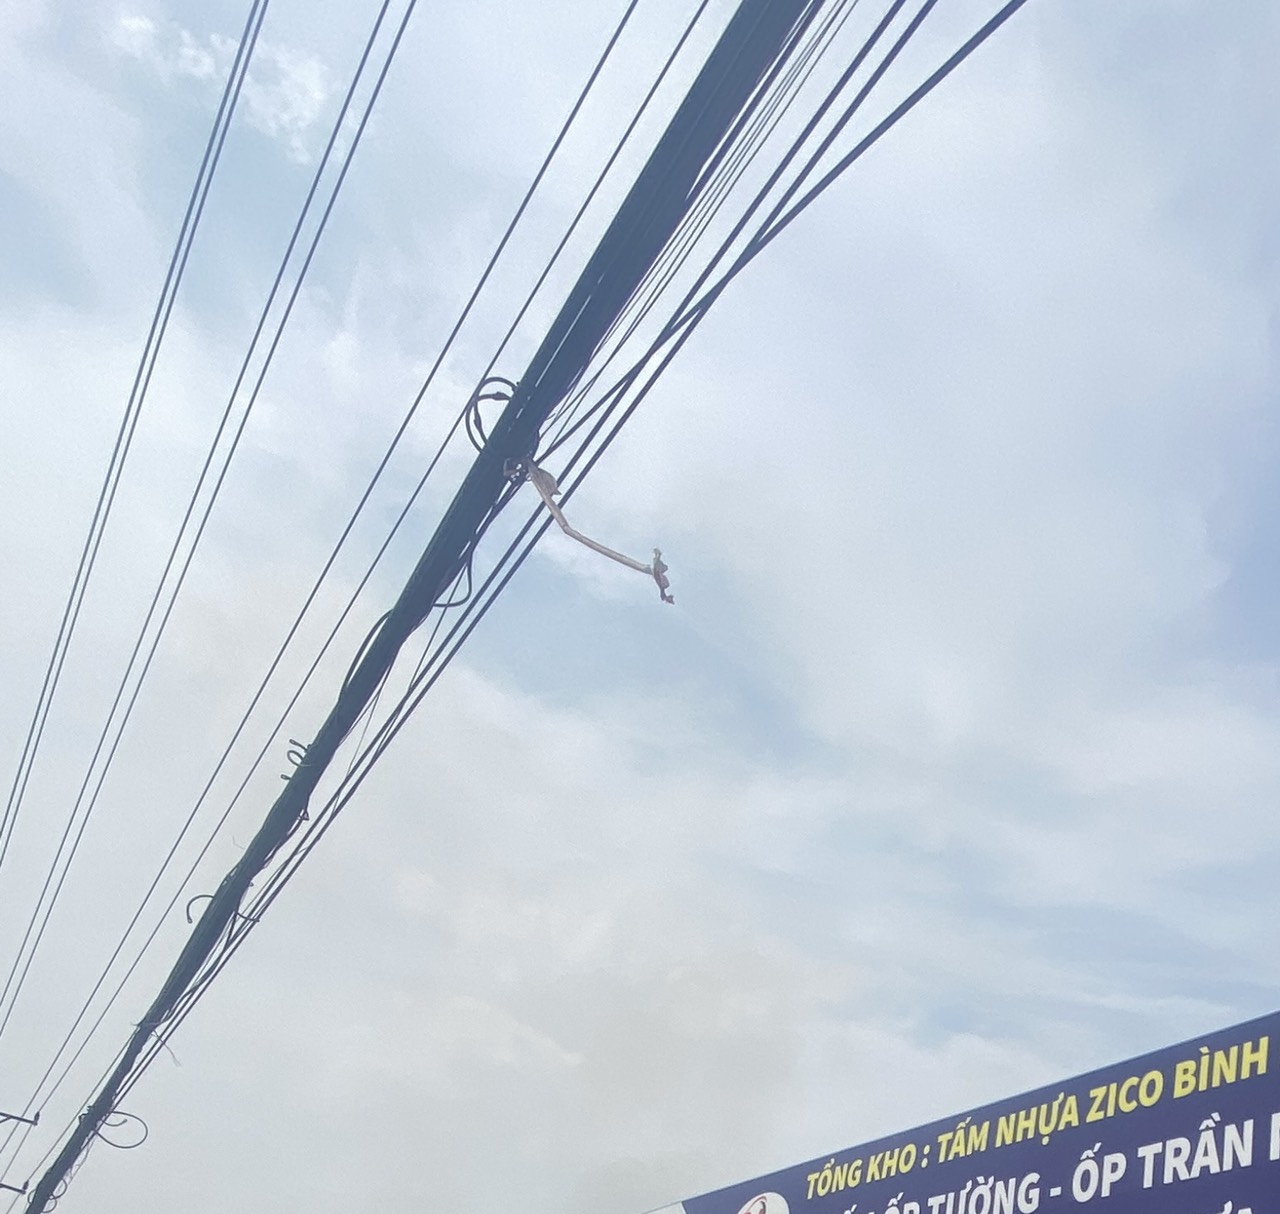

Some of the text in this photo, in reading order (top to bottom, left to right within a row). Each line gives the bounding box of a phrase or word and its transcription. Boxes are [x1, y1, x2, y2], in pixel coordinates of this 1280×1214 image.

[807, 1158, 863, 1200] TỔNG
[866, 1143, 916, 1182] KHO
[937, 1117, 990, 1164] TẤM
[995, 1092, 1079, 1145] NHỰA
[1086, 1069, 1164, 1123] ZICO
[1173, 1036, 1269, 1099] BÌNH
[1072, 1142, 1127, 1203] ỐP
[1138, 1112, 1254, 1189] TRẦN
